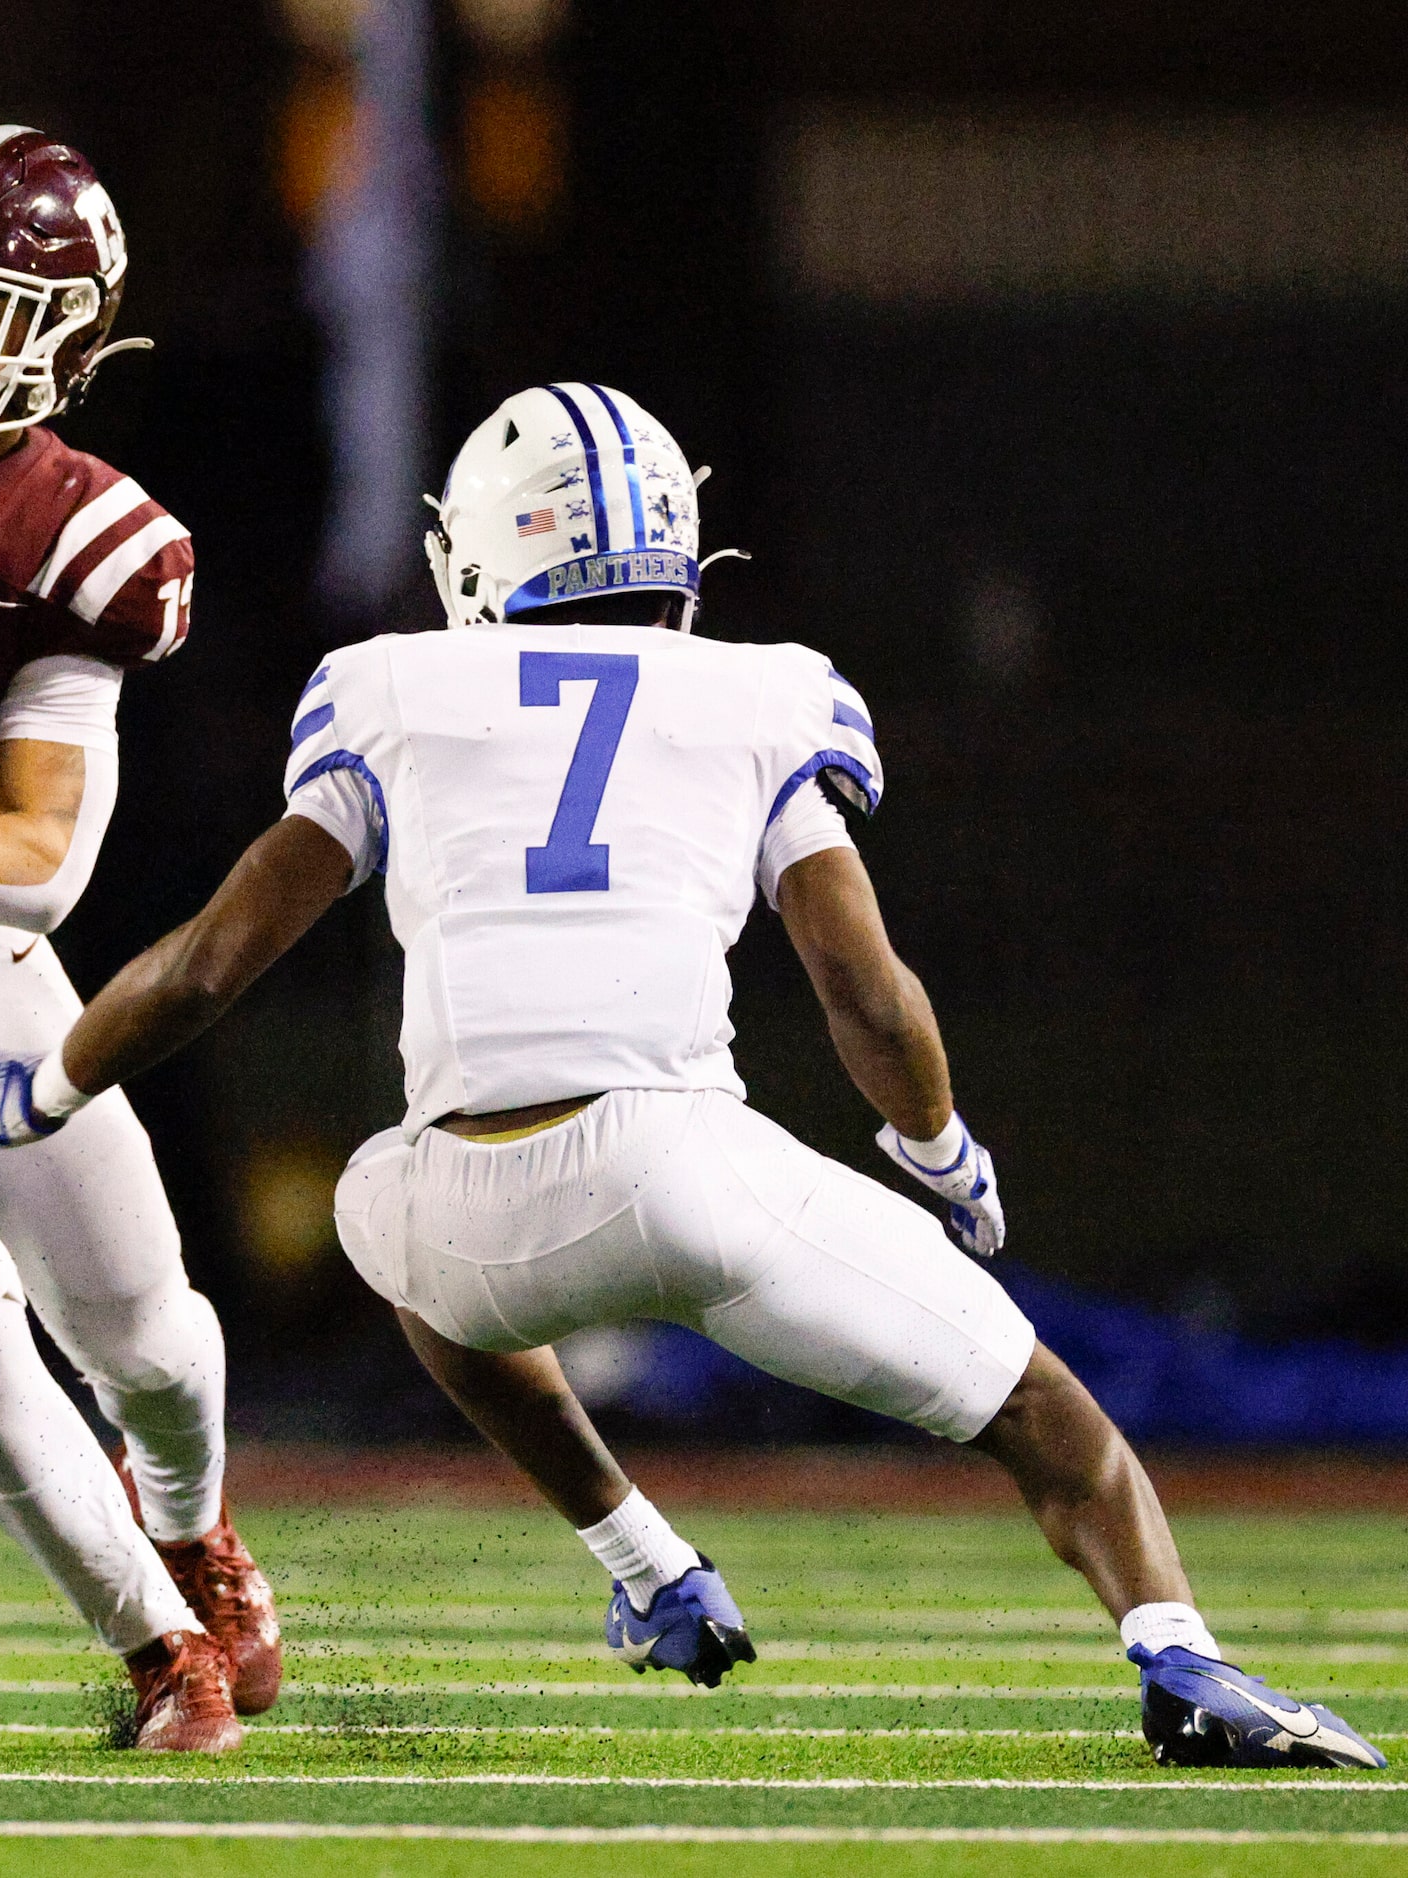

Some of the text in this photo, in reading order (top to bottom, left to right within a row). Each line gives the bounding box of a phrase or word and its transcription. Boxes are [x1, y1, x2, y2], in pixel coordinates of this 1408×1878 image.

[570, 532, 592, 553] M
[650, 529, 666, 543] M
[547, 551, 688, 599] PANTHERS
[520, 651, 639, 894] 7
